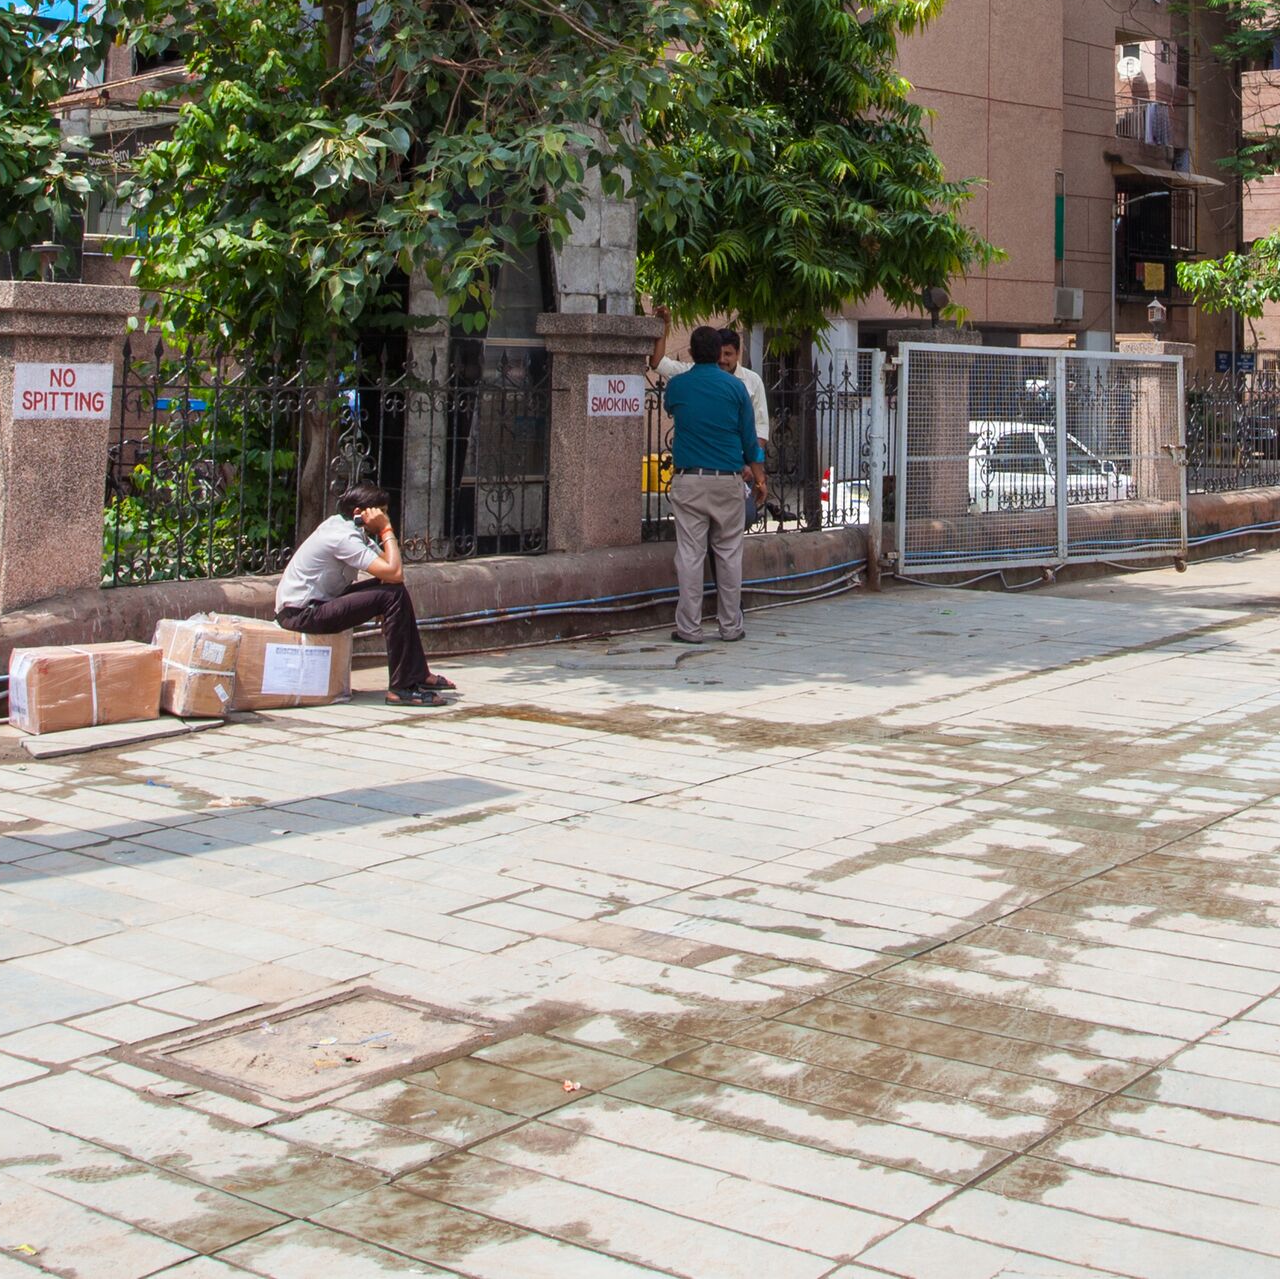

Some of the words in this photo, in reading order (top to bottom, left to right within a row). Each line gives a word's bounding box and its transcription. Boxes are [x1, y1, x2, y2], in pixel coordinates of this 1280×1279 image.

[49, 368, 76, 388] NO
[608, 379, 625, 394] NO
[22, 390, 104, 412] SPITTING
[591, 396, 640, 413] SMOKING
